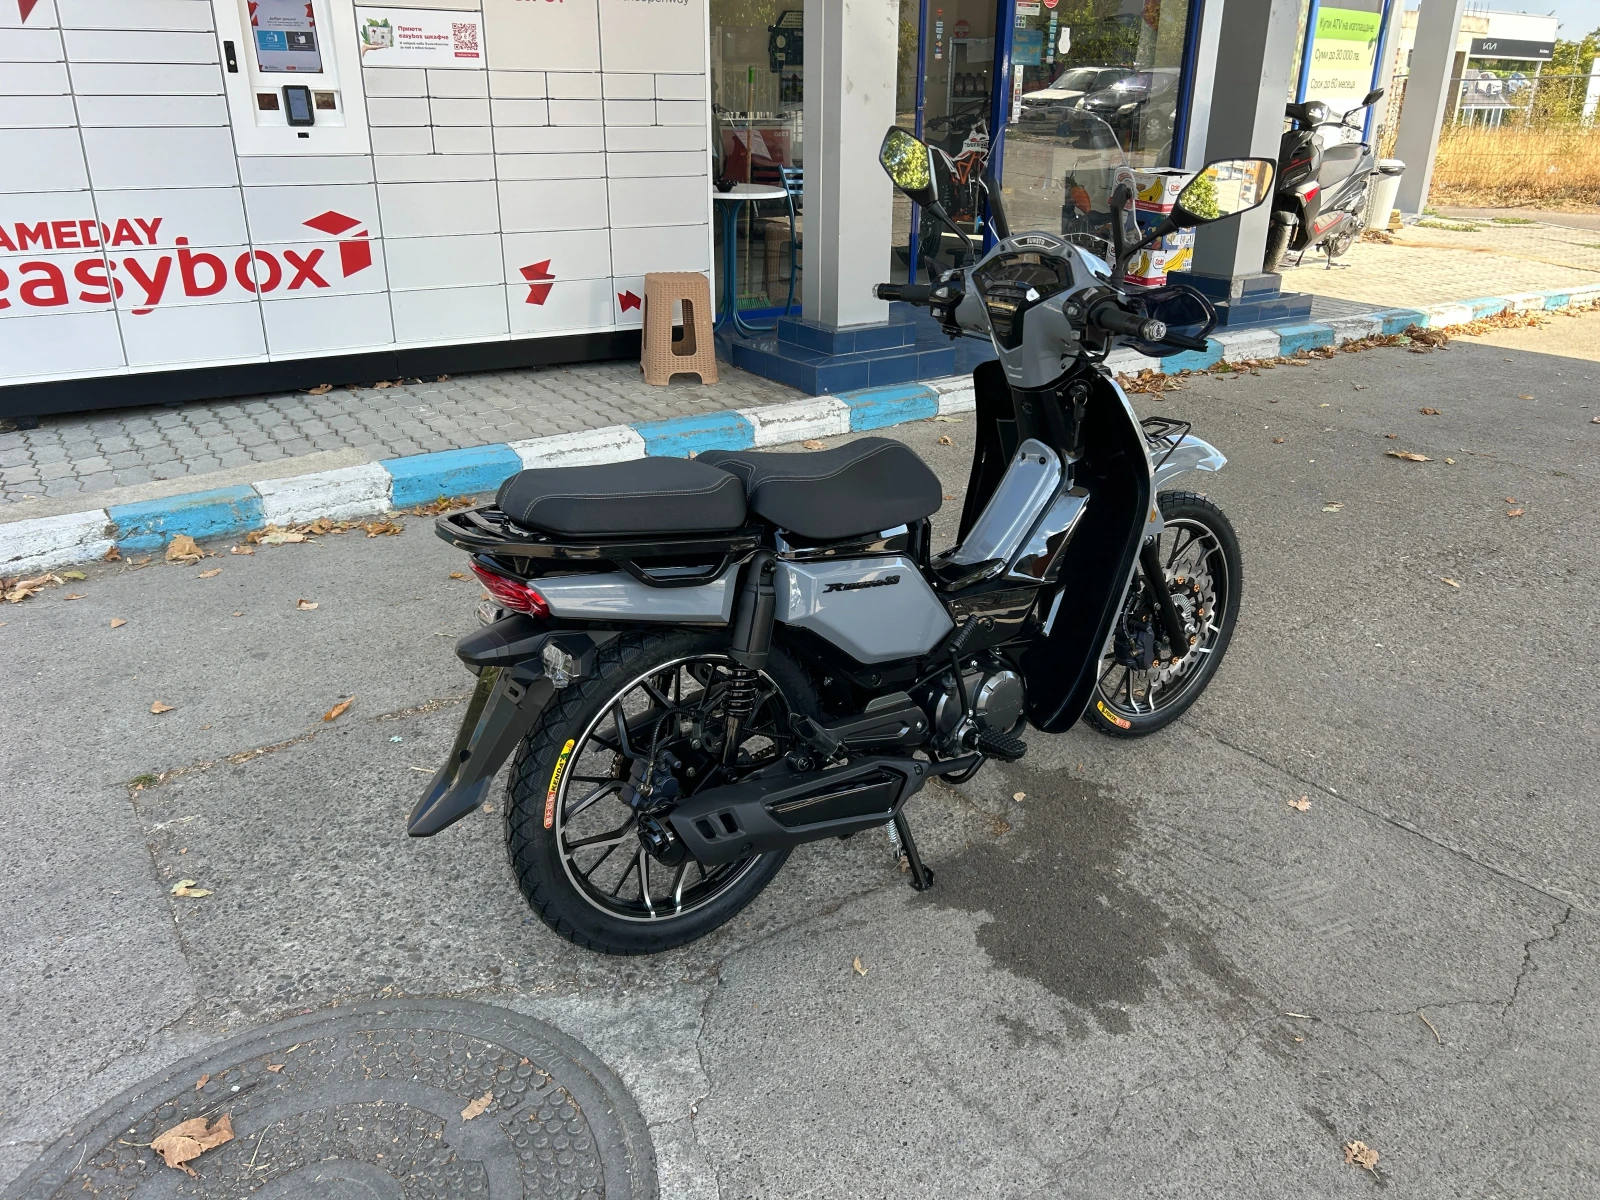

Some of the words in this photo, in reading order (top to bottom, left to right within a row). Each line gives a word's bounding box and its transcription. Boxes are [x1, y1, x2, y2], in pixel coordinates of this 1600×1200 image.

[1319, 18, 1332, 31] Купи
[1333, 18, 1343, 30] ATV
[1342, 22, 1348, 31] на
[1349, 22, 1374, 33] изплащане
[1315, 48, 1328, 61] Суми
[1328, 52, 1335, 61] до
[1336, 49, 1343, 60] 30
[1343, 49, 1353, 60] 000
[1310, 78, 1323, 90] Срок
[1324, 80, 1330, 89] до
[1331, 78, 1338, 88] 60
[1338, 80, 1356, 90] месеца
[0, 237, 331, 316] asybox
[551, 761, 566, 791] KENDA
